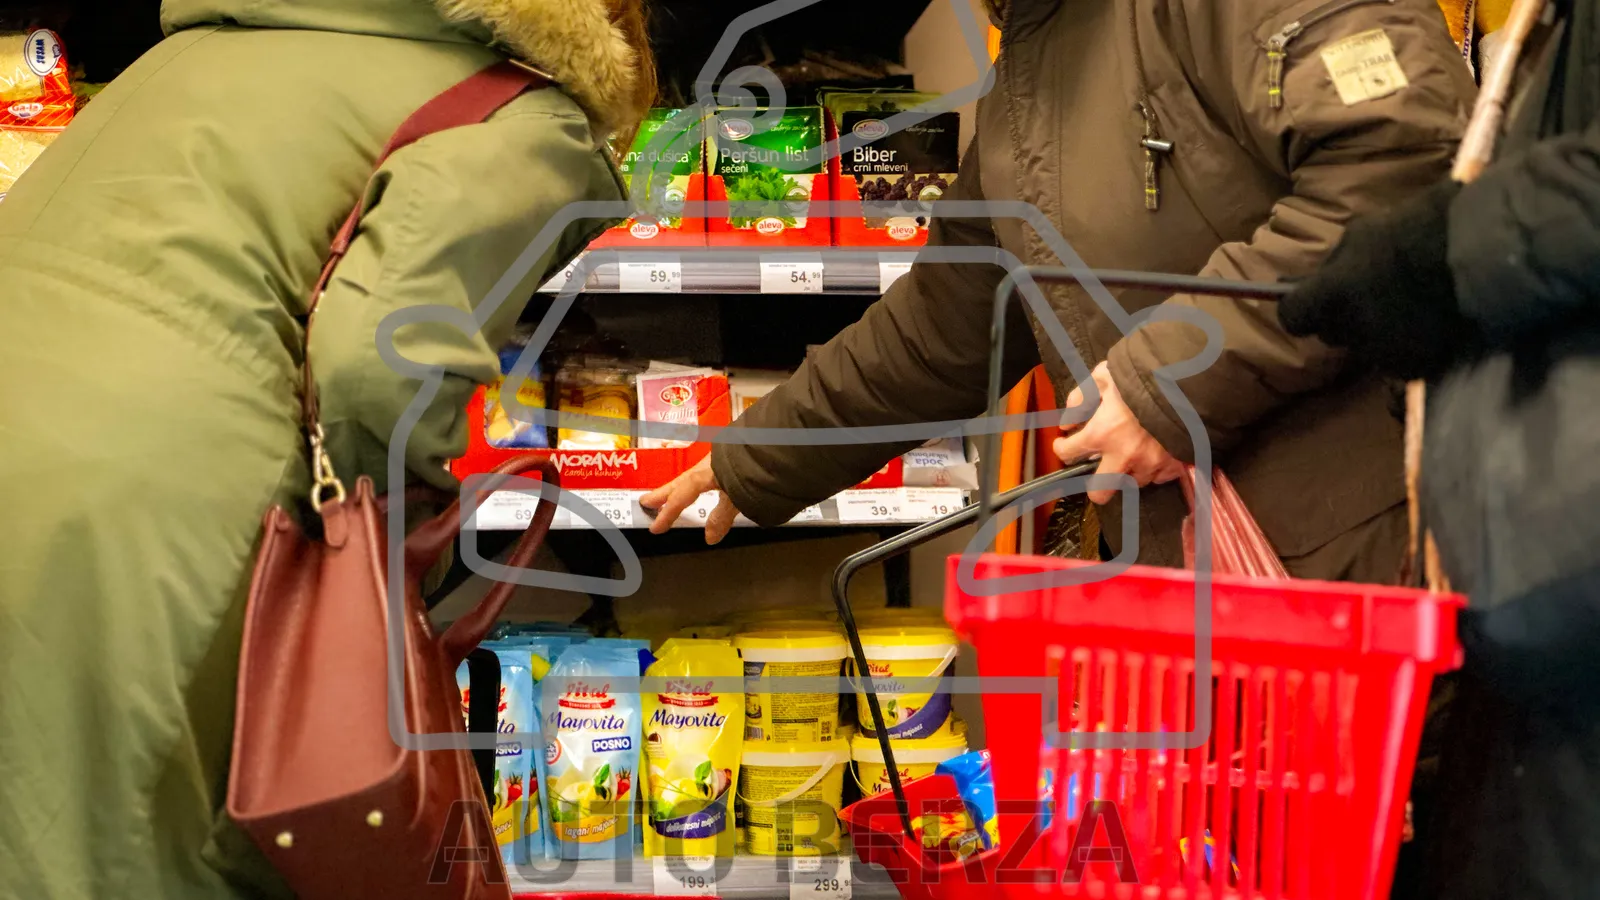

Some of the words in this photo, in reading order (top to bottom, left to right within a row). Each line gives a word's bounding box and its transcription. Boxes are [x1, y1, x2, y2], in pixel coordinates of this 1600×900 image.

[720, 145, 780, 163] Peršun
[785, 145, 809, 162] list
[853, 145, 897, 163] Biber
[720, 164, 749, 174] sečeni
[853, 162, 872, 172] crni
[873, 162, 909, 172] mleveni
[631, 222, 657, 235] aleva
[758, 219, 783, 232] aleva
[890, 225, 915, 236] aleva
[549, 450, 638, 474] MORAVKA
[547, 710, 626, 733] Mayovita
[648, 708, 727, 730] Mayovita
[495, 744, 521, 755] SNO
[593, 738, 631, 752] POSNO
[564, 825, 591, 840] lagani
